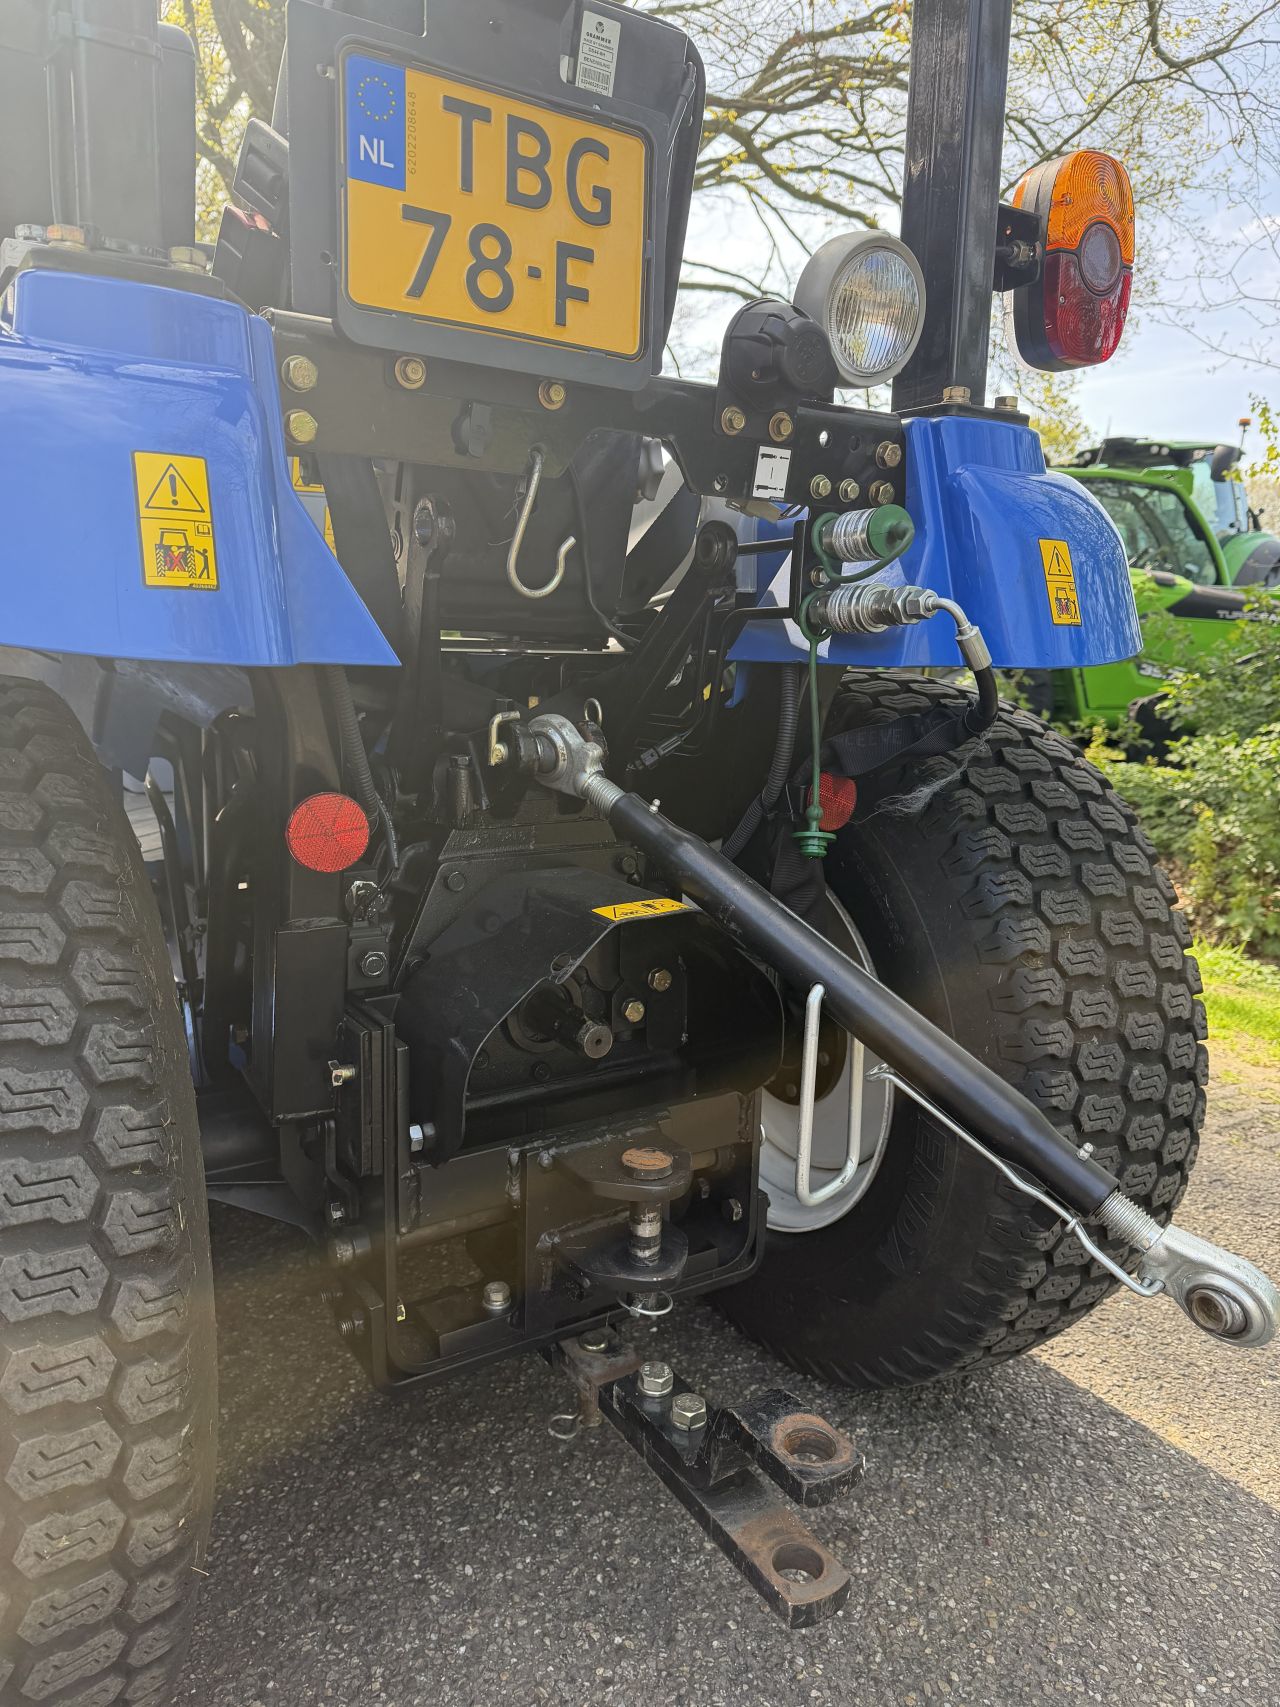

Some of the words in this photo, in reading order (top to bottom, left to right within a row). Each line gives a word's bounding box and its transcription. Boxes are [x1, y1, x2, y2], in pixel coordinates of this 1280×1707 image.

[360, 134, 394, 169] NL
[442, 94, 612, 226] TBG
[401, 203, 595, 327] 78-F
